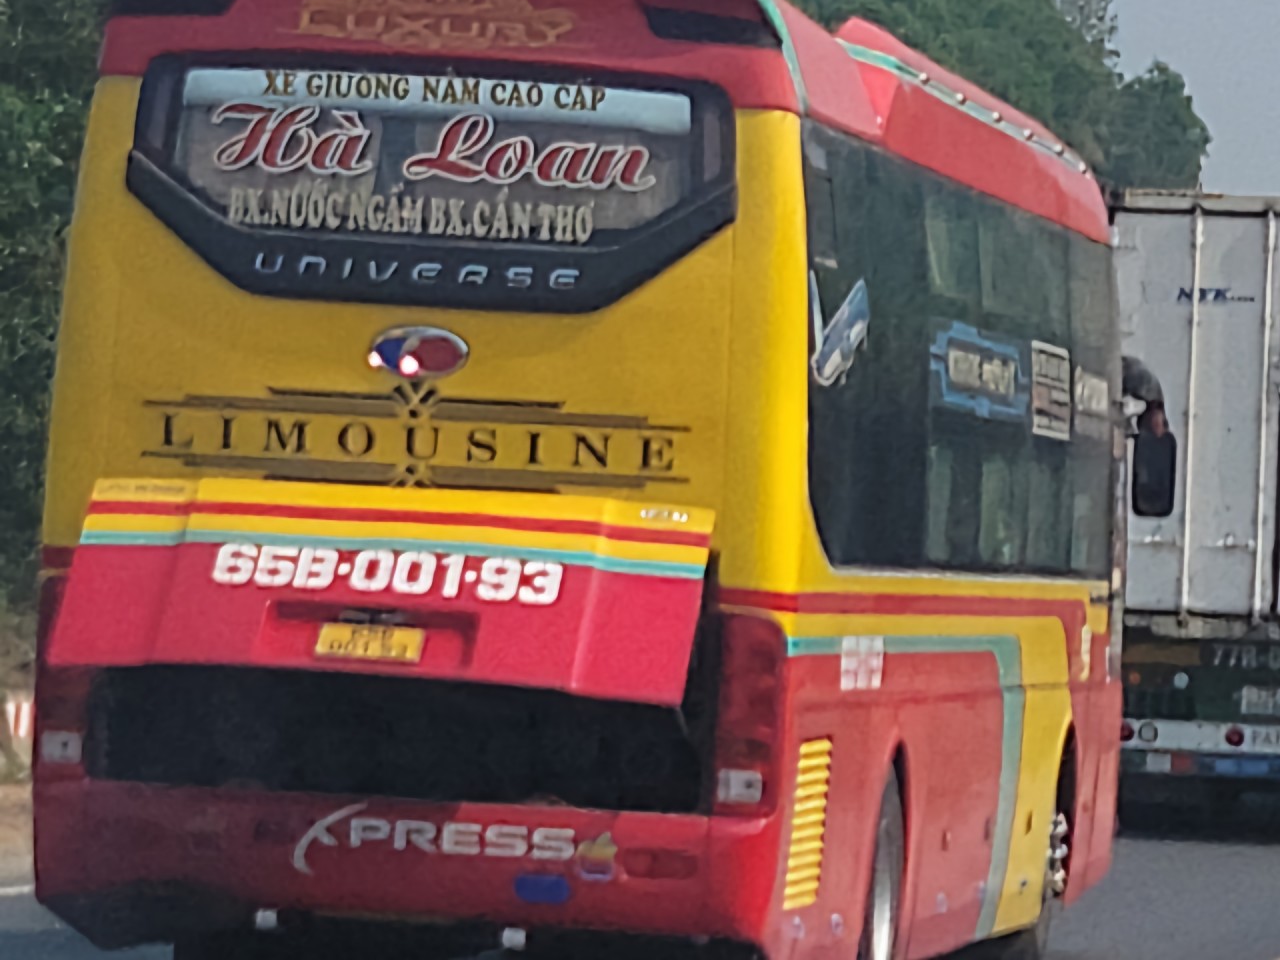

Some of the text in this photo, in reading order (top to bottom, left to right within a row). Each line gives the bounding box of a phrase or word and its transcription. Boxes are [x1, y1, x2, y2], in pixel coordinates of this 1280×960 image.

[263, 69, 297, 97] XE
[490, 82, 543, 107] CAO
[211, 102, 656, 191] Hà Loan
[161, 411, 676, 472] LIMOUSINE
[293, 802, 575, 876] XPRESS
